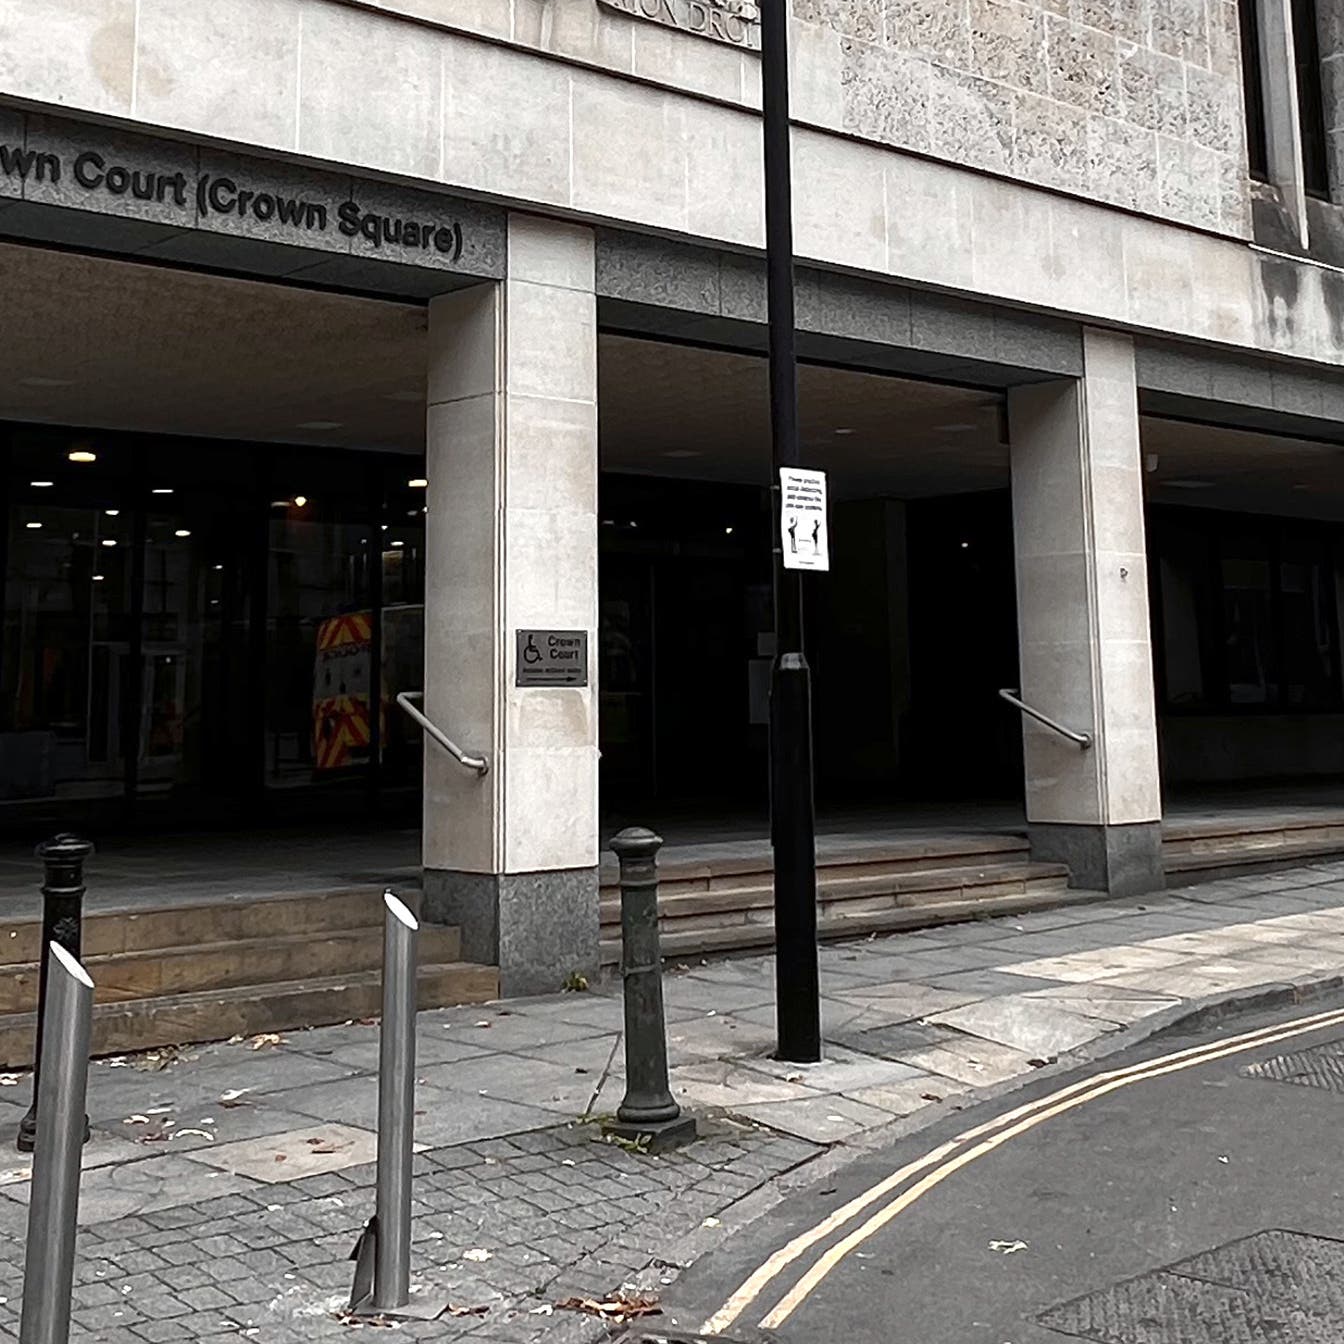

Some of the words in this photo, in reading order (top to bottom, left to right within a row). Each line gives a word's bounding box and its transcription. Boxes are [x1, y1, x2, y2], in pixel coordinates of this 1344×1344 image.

[688, 1, 759, 47] DROI
[73, 151, 187, 206] Court
[196, 174, 327, 231] (Crown
[337, 201, 463, 261] Square)
[548, 635, 580, 647] Crown
